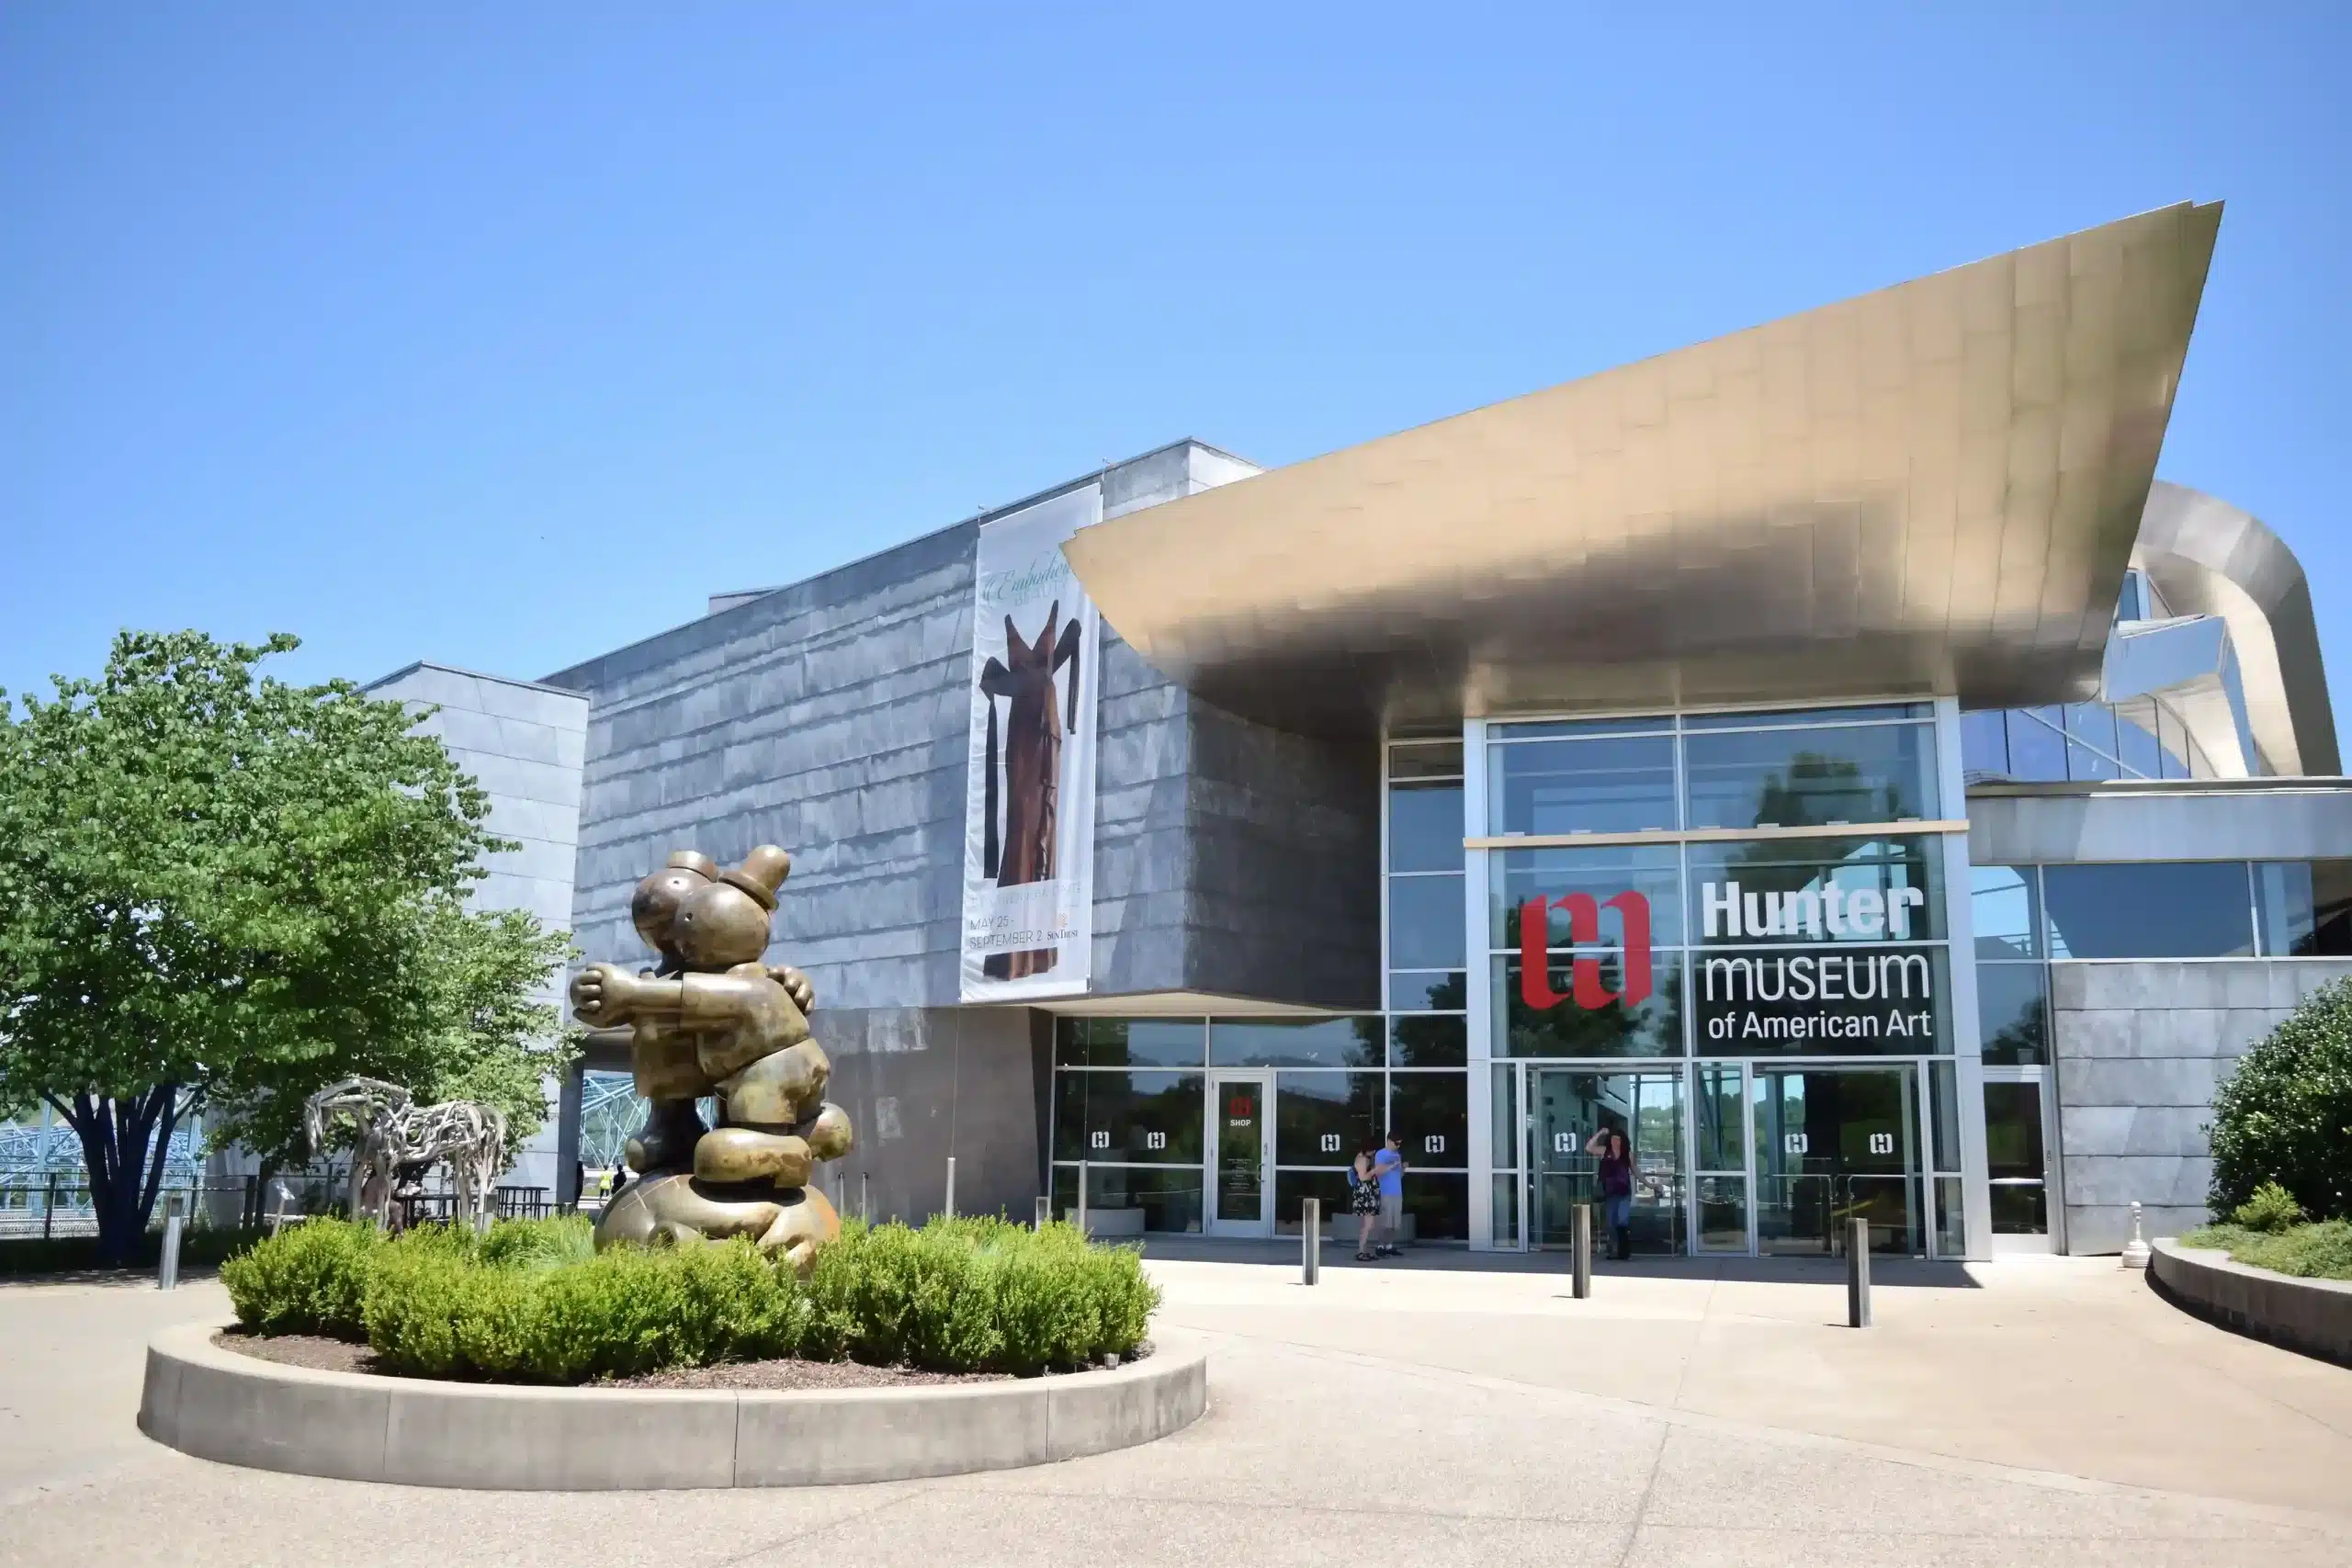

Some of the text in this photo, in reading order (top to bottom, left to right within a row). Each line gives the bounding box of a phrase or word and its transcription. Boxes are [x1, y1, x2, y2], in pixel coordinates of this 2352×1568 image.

[1702, 881, 1924, 938] Hunter
[970, 917, 993, 930] MAY
[969, 930, 1044, 949] SEPTEMBER 2
[1708, 1009, 1932, 1039] of American Art
[1229, 1119, 1251, 1127] SHOP
